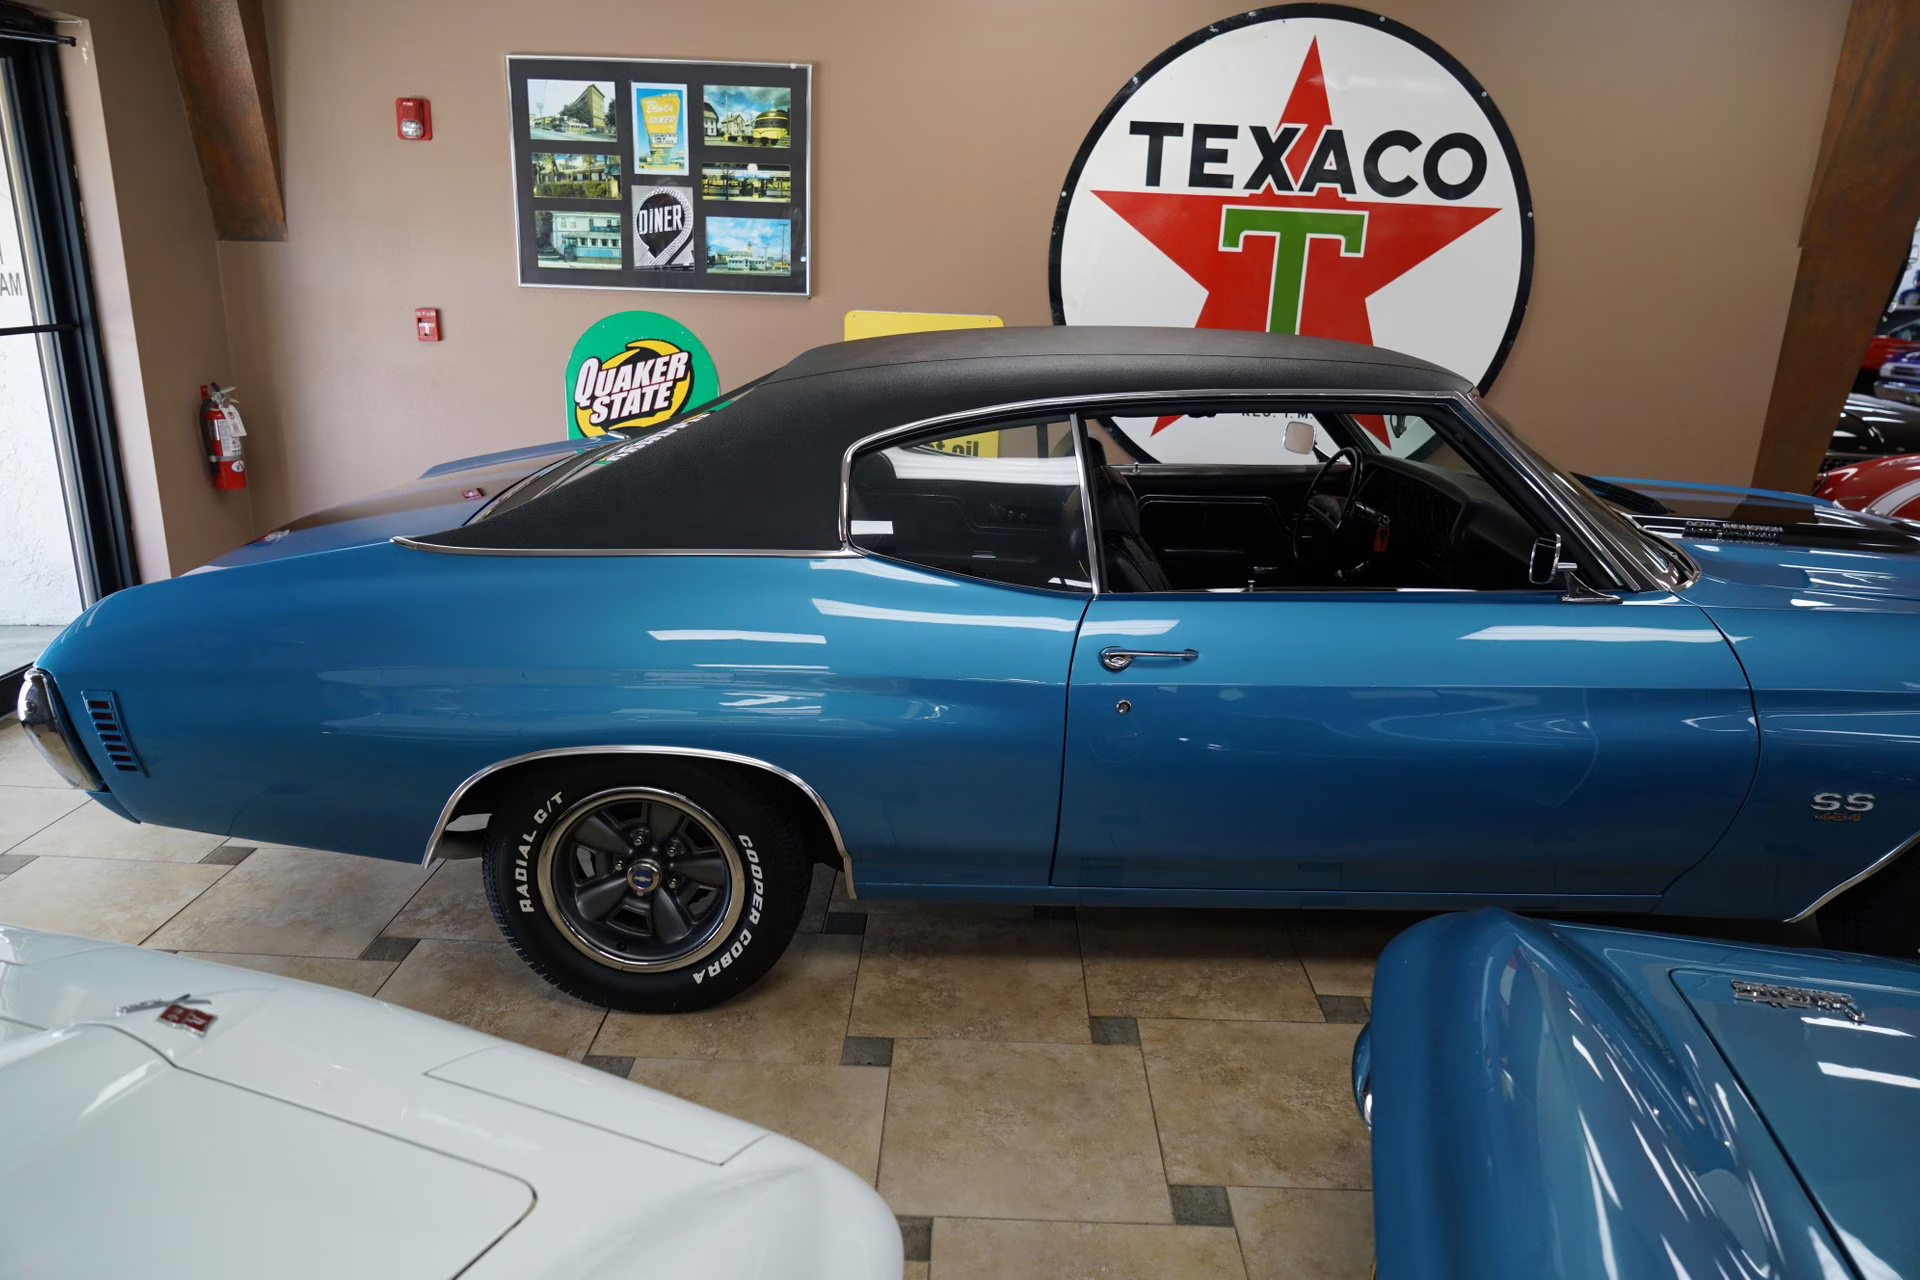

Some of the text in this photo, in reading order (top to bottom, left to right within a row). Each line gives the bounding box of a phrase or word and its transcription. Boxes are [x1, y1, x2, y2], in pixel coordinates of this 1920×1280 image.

[1129, 120, 1488, 200] TEXACO
[639, 204, 682, 235] DINER
[1218, 204, 1369, 335] T
[574, 351, 690, 408] QUAKER
[590, 380, 675, 425] STATE
[1809, 792, 1876, 811] SS
[515, 791, 564, 913] RADIAL G/T
[692, 834, 764, 985] COOPER COBRA
